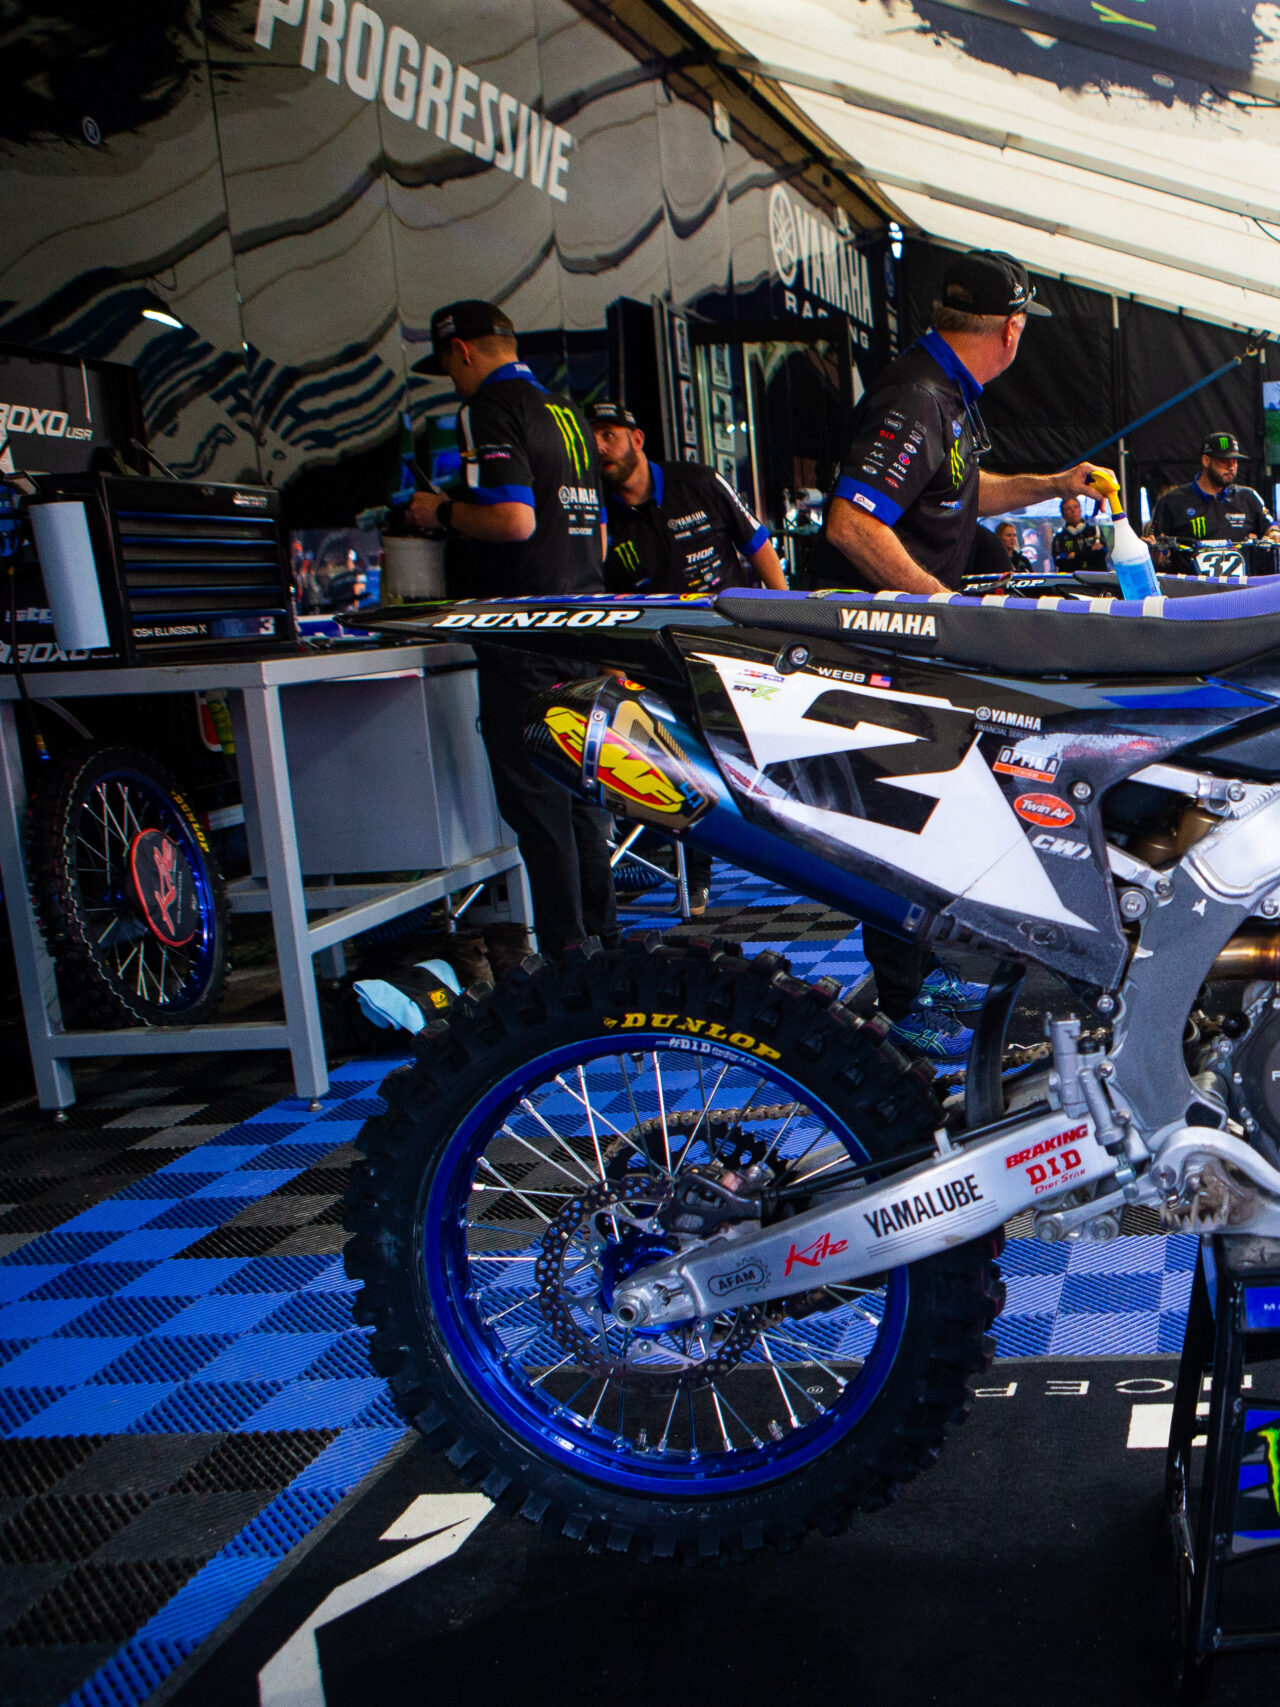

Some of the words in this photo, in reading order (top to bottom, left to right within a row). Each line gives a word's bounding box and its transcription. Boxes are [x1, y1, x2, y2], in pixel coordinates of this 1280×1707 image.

[254, 0, 570, 203] PROGRESSIVE
[794, 203, 875, 330] YAMAHA
[65, 426, 93, 441] USA
[686, 546, 715, 564] THOR
[1200, 551, 1243, 577] 32
[433, 610, 640, 629] DUNLOP
[841, 608, 937, 637] YAMAHA
[818, 665, 866, 683] WEBB
[991, 709, 1042, 732] YAMAHA
[1021, 799, 1051, 815] Twin
[1050, 806, 1072, 821] Air
[620, 1012, 782, 1061] DUNLOP
[1005, 1123, 1089, 1171] BRAKING
[863, 1173, 984, 1239] YAMALUBE
[784, 1232, 850, 1277] Kite
[718, 1269, 757, 1291] AFAM
